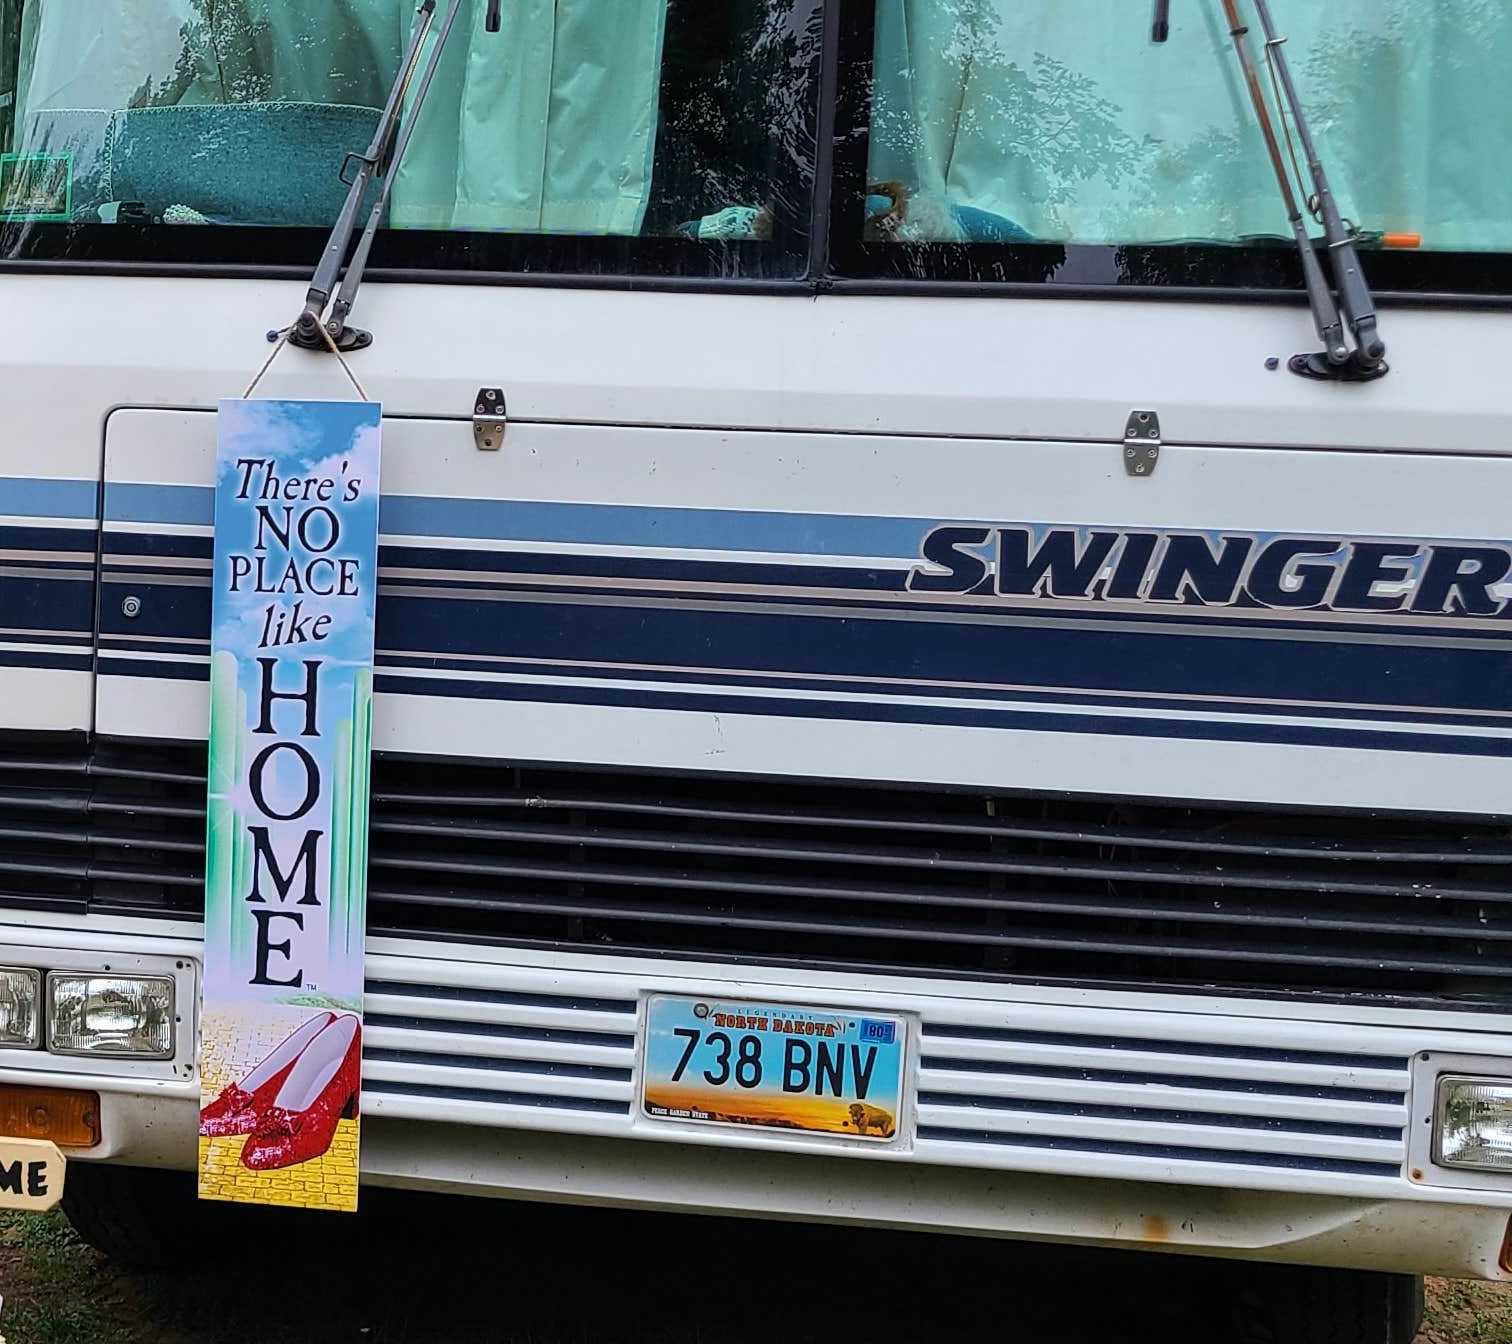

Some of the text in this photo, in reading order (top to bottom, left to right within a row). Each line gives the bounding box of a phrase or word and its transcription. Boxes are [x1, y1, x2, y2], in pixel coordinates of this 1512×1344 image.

[235, 457, 361, 504] There's
[254, 505, 340, 554] NO
[229, 556, 360, 598] PLACE
[906, 525, 1512, 616] SWINGER
[258, 600, 333, 649] like
[245, 657, 323, 989] HOME
[714, 1013, 836, 1038] NORTH DAKOTA
[671, 1028, 879, 1100] 738 BNV
